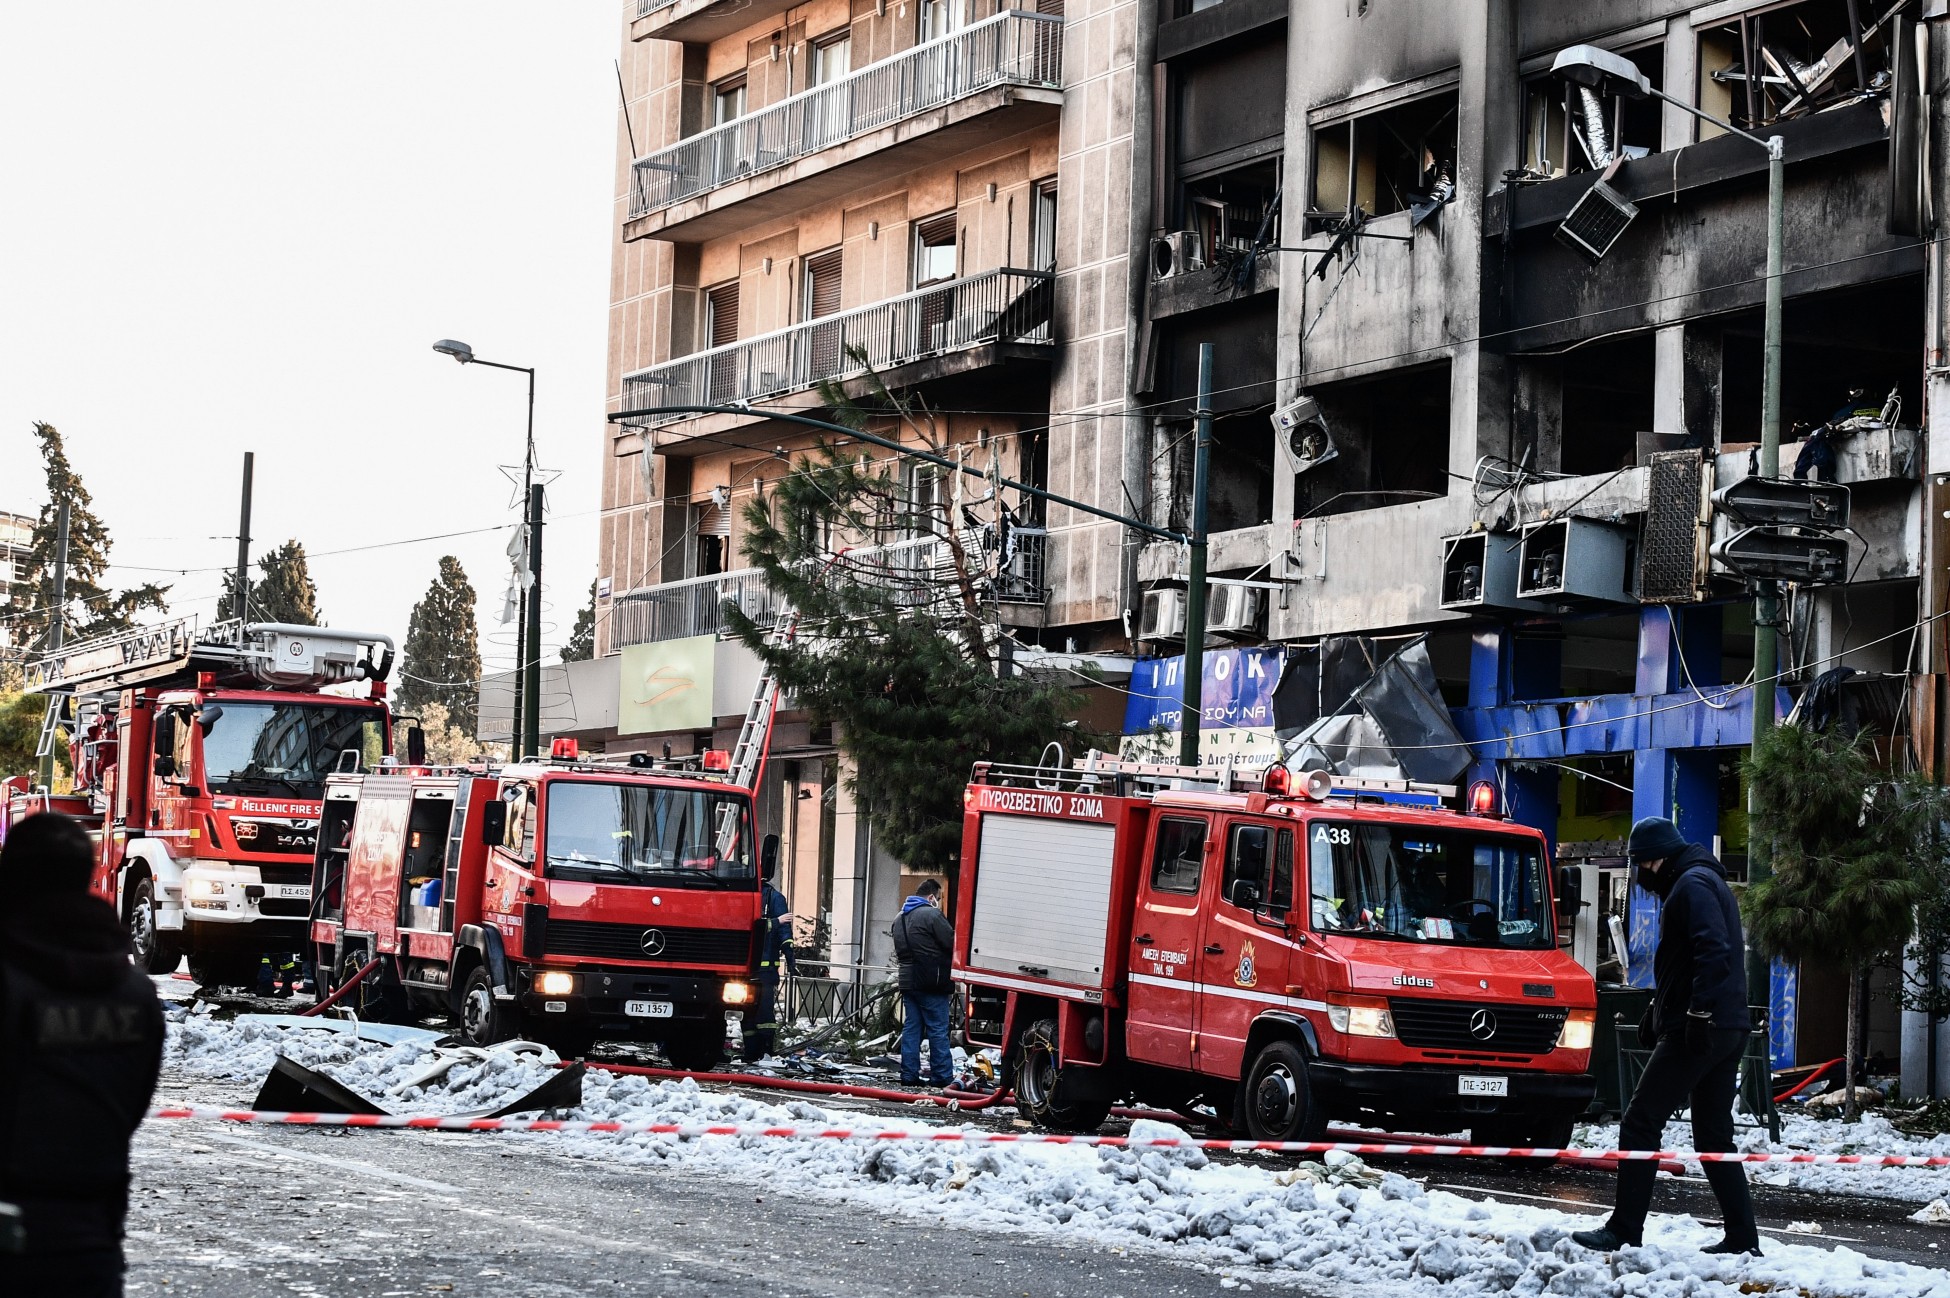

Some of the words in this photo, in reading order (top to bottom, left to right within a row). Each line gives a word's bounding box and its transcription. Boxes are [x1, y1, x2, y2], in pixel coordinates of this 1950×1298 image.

[1205, 707, 1237, 720] ΣΟΥ
[1243, 706, 1266, 718] ΝΑ
[241, 801, 288, 813] HELLENIC
[289, 804, 312, 815] FIRE
[979, 789, 1063, 814] ΠΥΡΟΣΒΕΣΤΙΚΟ
[1069, 797, 1104, 818] ΣΩΜΑ
[1314, 826, 1351, 845] A38
[281, 887, 311, 897] Π.Σ.452
[1392, 974, 1435, 988] sides
[648, 1005, 667, 1013] 1357
